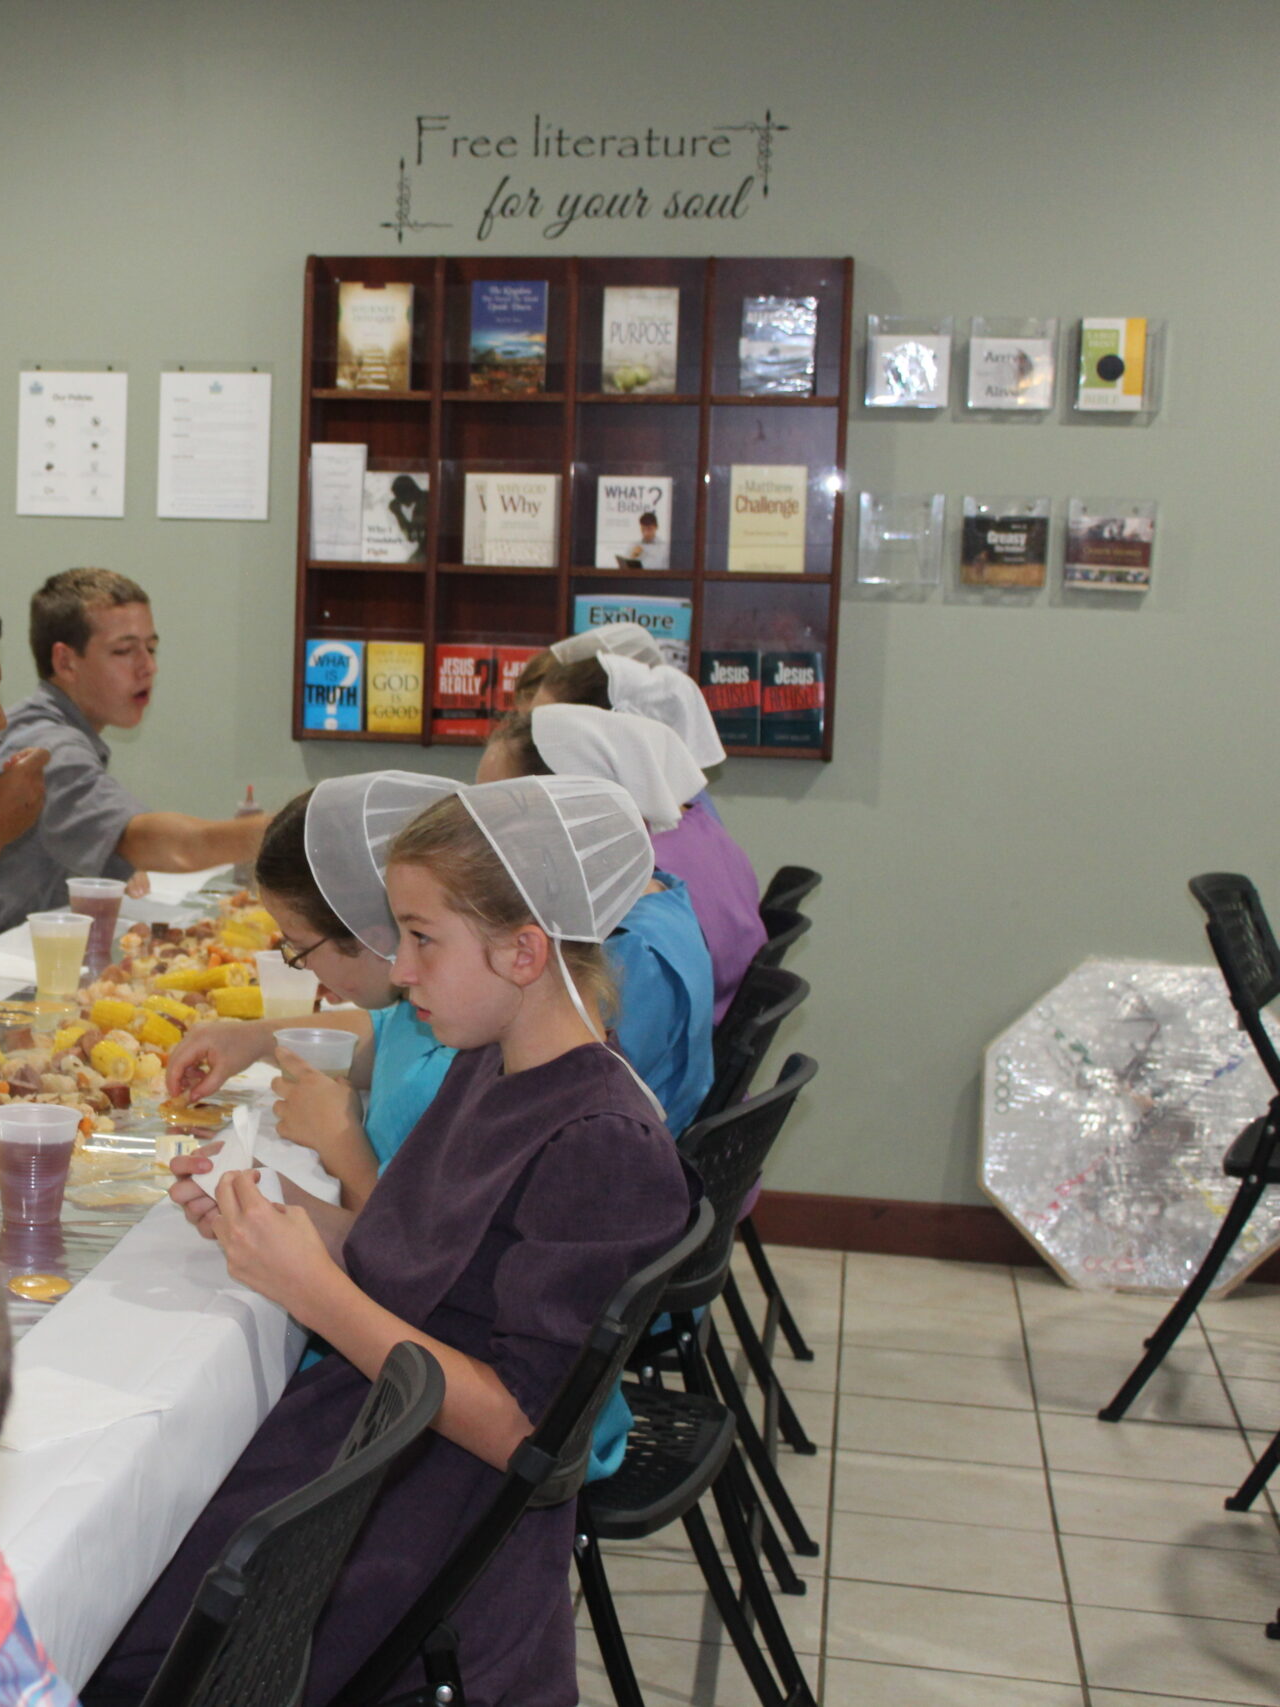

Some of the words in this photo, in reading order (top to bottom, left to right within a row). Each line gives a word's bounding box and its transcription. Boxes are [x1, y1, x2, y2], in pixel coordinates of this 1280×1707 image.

[416, 115, 518, 165] Free
[532, 113, 732, 159] literature
[476, 175, 544, 241] for
[542, 191, 653, 240] your
[663, 175, 755, 220] soul
[610, 320, 673, 346] PURPOSE
[605, 485, 645, 499] WHAT
[500, 494, 542, 518] Why
[735, 495, 800, 519] Challenge
[987, 530, 1027, 546] Greasy
[589, 606, 674, 630] Explore
[313, 655, 354, 668] WHAT
[439, 657, 475, 675] JESUS
[710, 660, 750, 684] Jesus
[325, 670, 337, 682] IS
[372, 672, 419, 692] GOD
[774, 661, 814, 685] Jesus
[305, 684, 357, 706] TRUTH
[439, 675, 482, 695] REALLY
[372, 705, 419, 719] GOOD
